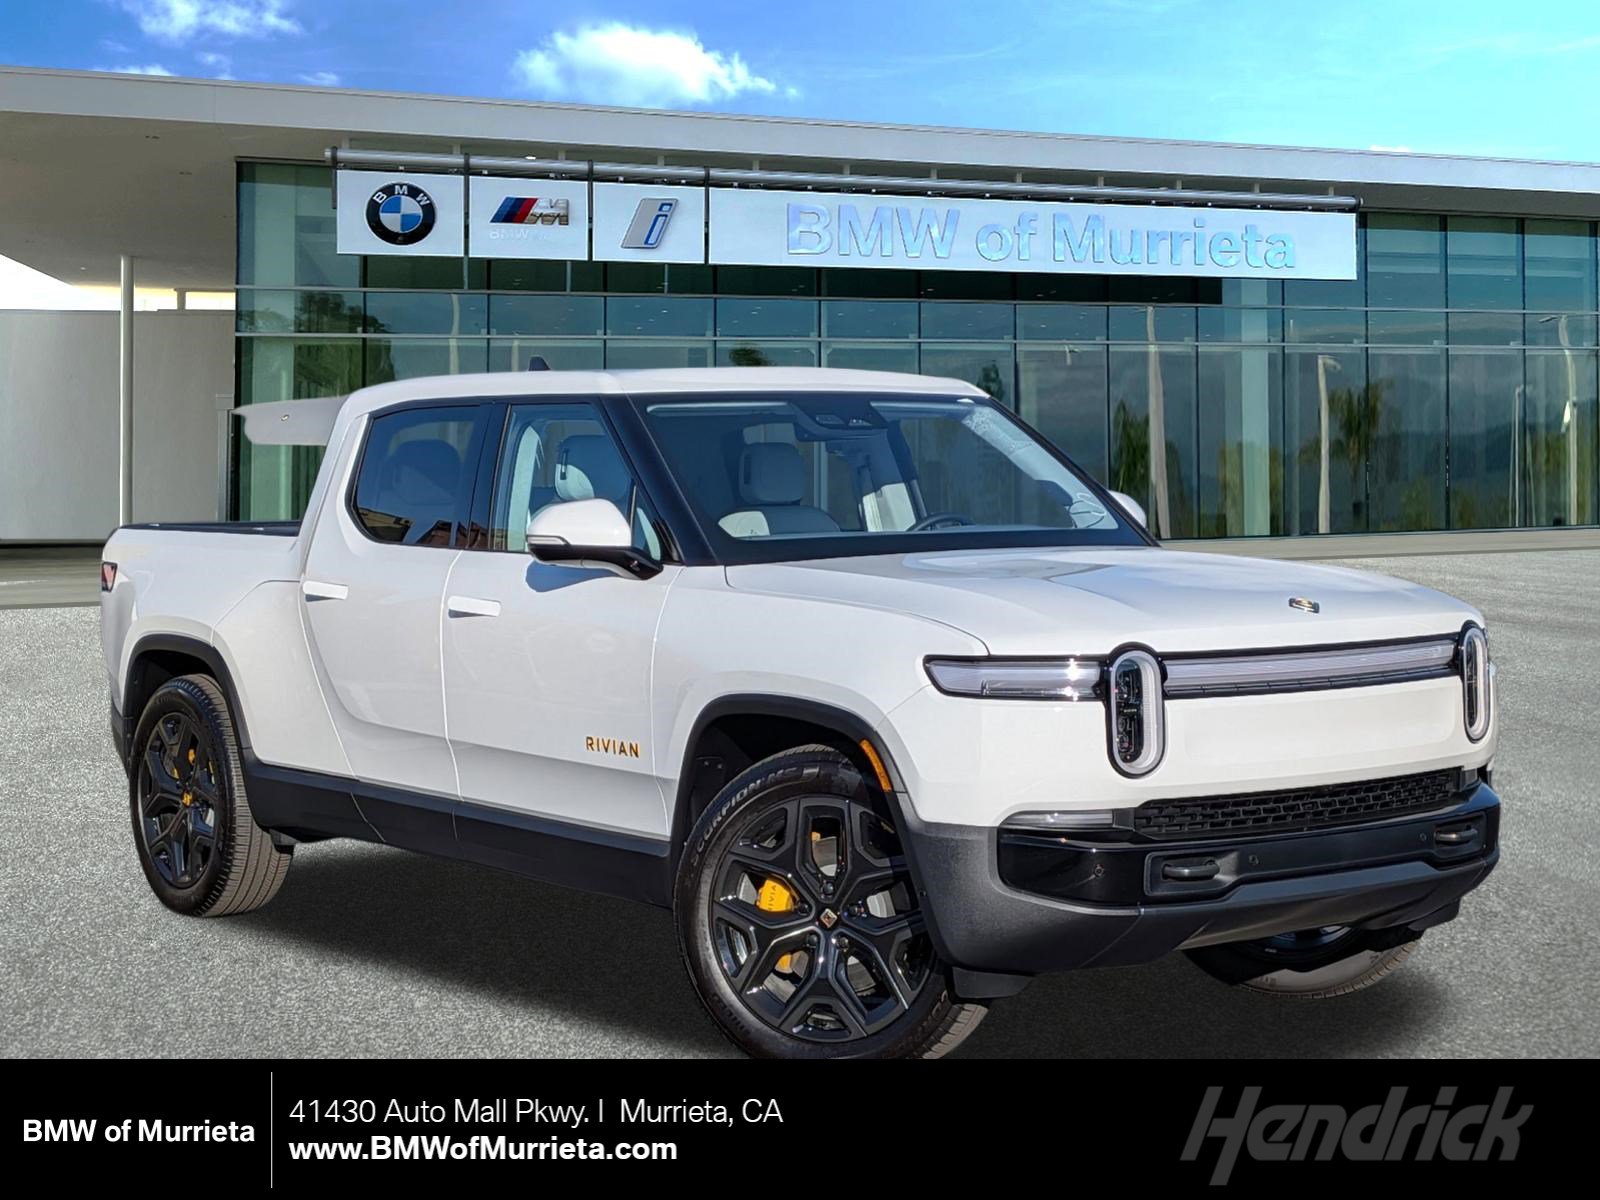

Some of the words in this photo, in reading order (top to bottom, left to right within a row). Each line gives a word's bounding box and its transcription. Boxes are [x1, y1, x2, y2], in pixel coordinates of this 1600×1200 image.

[372, 183, 431, 207] BMW
[786, 202, 961, 259] BMW
[975, 210, 1038, 262] of
[1052, 212, 1296, 269] Murrieta
[585, 735, 640, 759] RIVIAN
